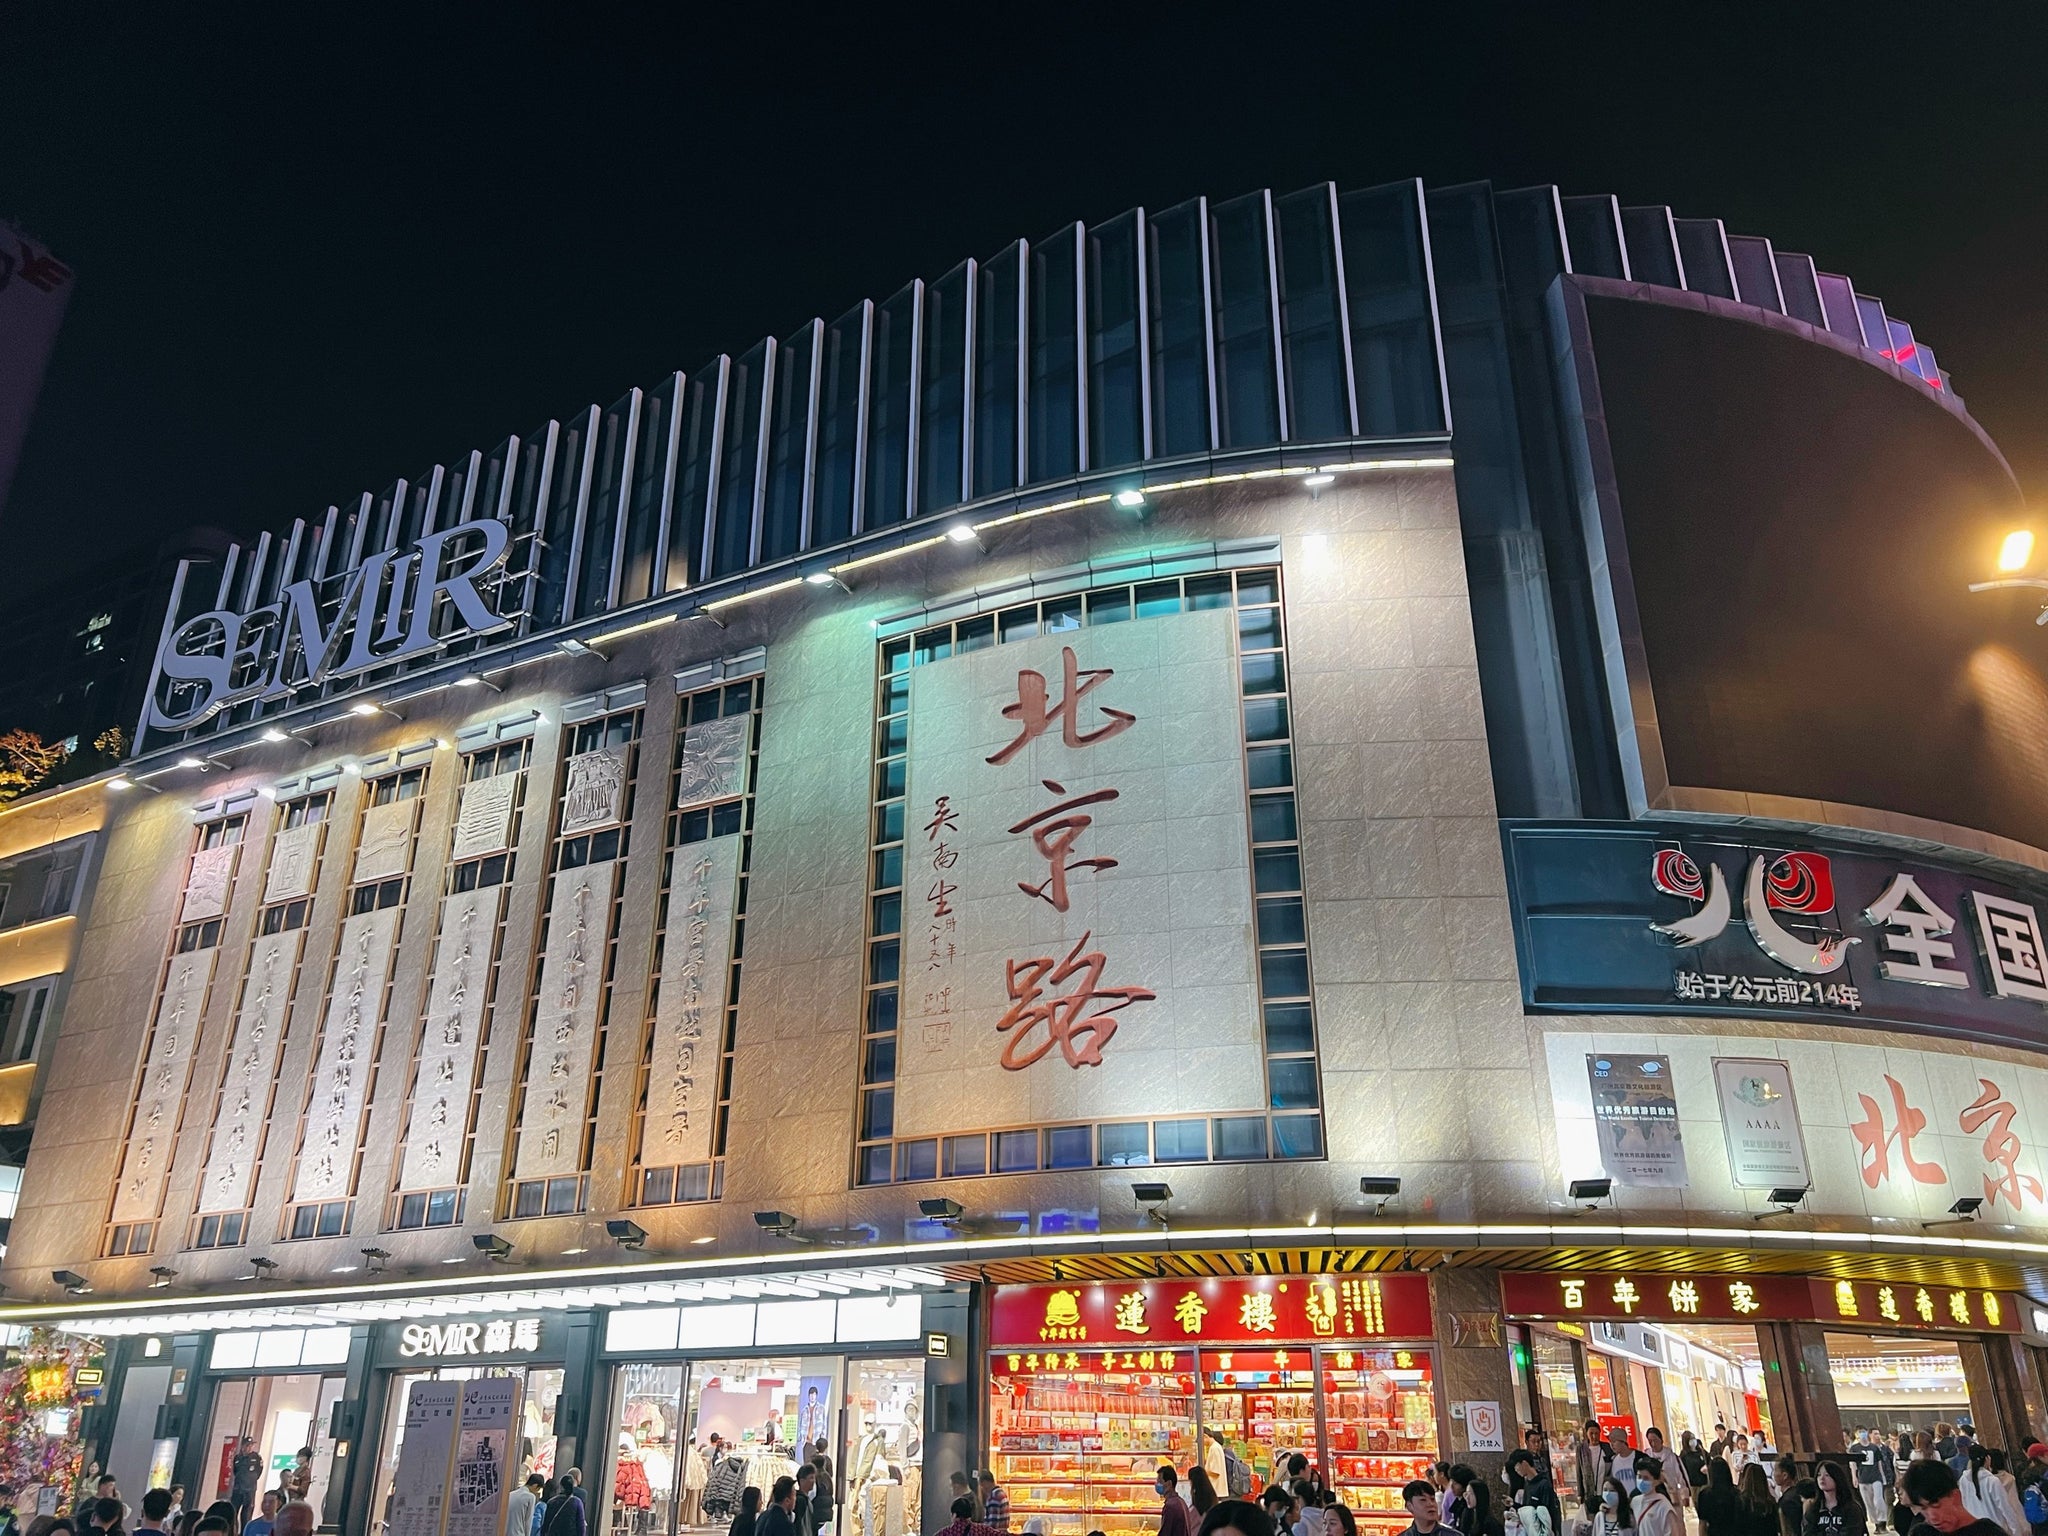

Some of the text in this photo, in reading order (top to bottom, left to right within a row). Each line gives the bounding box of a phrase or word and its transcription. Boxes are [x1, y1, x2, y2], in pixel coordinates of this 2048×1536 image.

[150, 517, 514, 731] SEMIR
[985, 646, 1157, 1071] 北京路
[1675, 971, 1862, 1011] 始于公元前214年
[1850, 1073, 2044, 1211] 北京
[400, 1322, 481, 1357] SEMIR
[1472, 1439, 1502, 1448] 犬只禁入
[1602, 1425, 1632, 1436] SE
